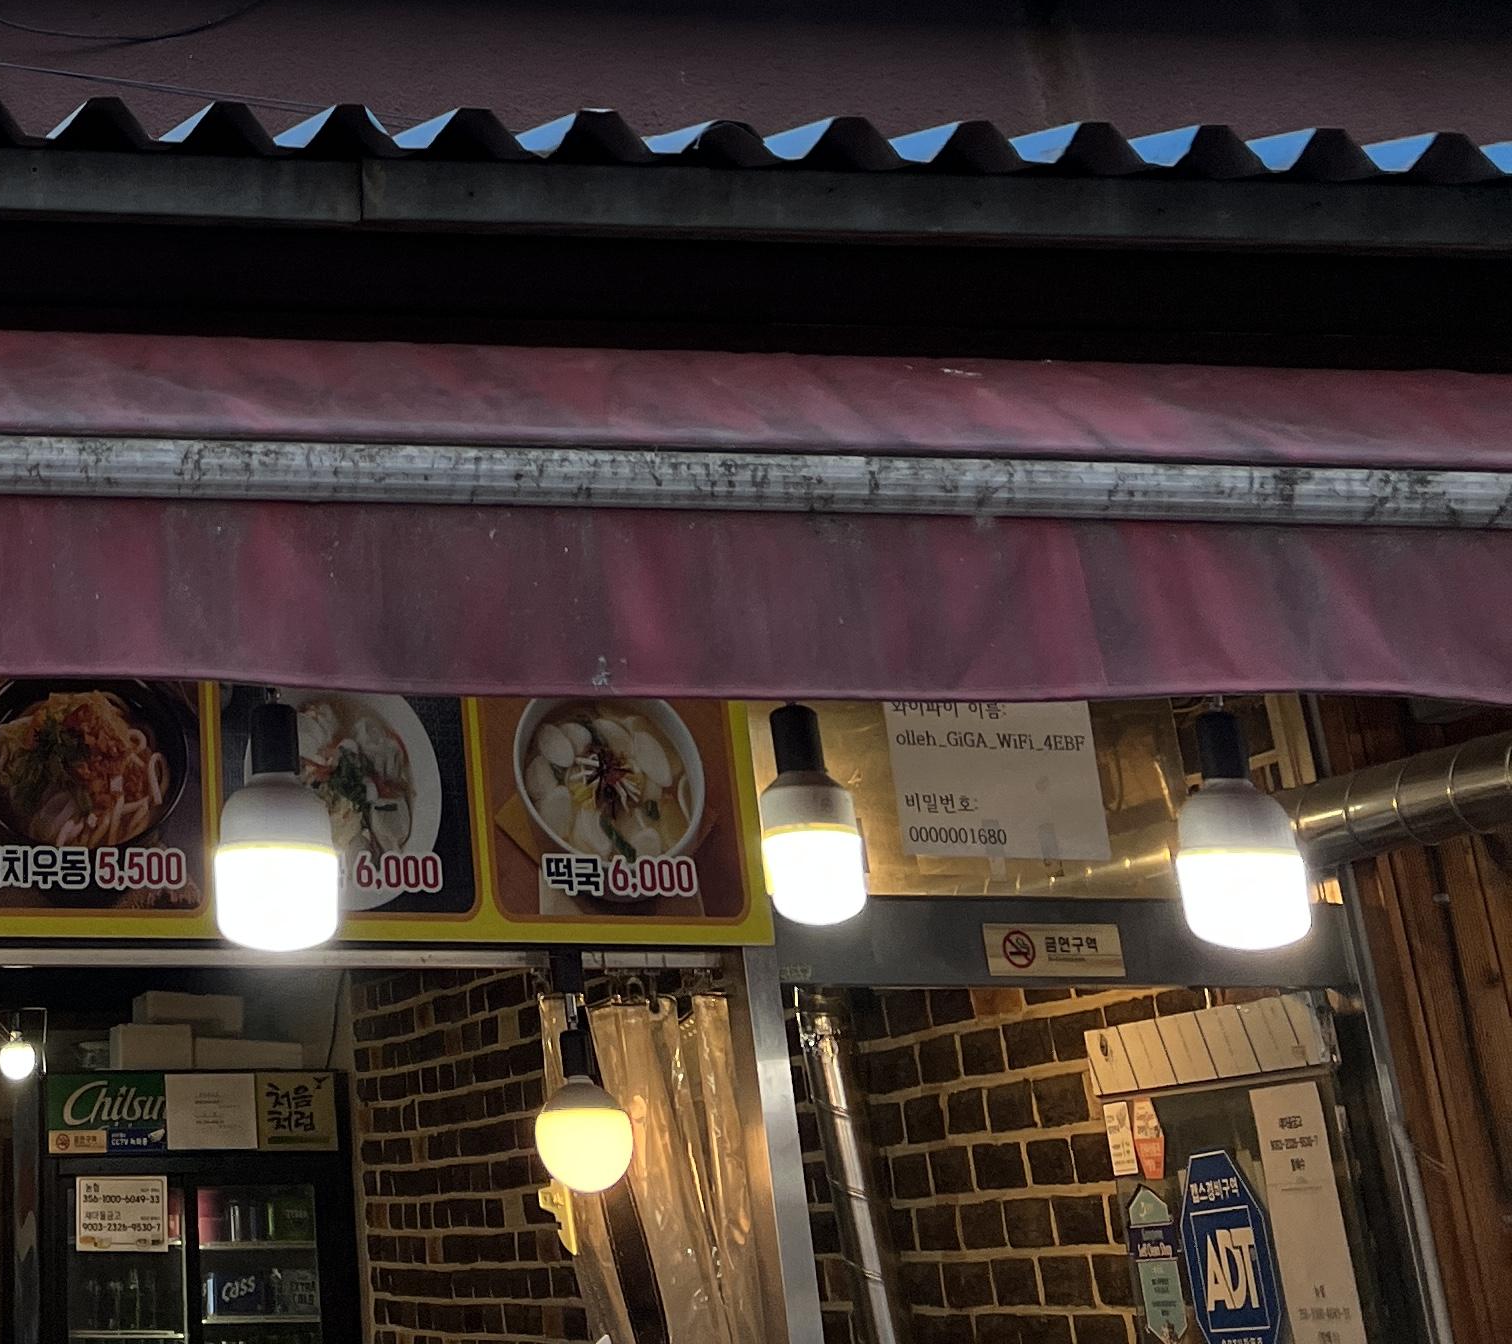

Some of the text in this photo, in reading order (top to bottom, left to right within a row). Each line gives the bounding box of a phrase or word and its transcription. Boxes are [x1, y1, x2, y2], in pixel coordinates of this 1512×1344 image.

[895, 729, 1086, 752] olleh_GiGA_WiFi_4EBF
[904, 792, 979, 813] 비밀번호:
[908, 825, 1008, 846] 0000001680
[97, 850, 184, 889] 5,500
[356, 854, 440, 890] 6,000
[544, 855, 695, 897] 떡국 6,000
[1044, 936, 1099, 953] 금연구역
[1206, 1226, 1261, 1313] ADT
[221, 1275, 256, 1303] Cass
